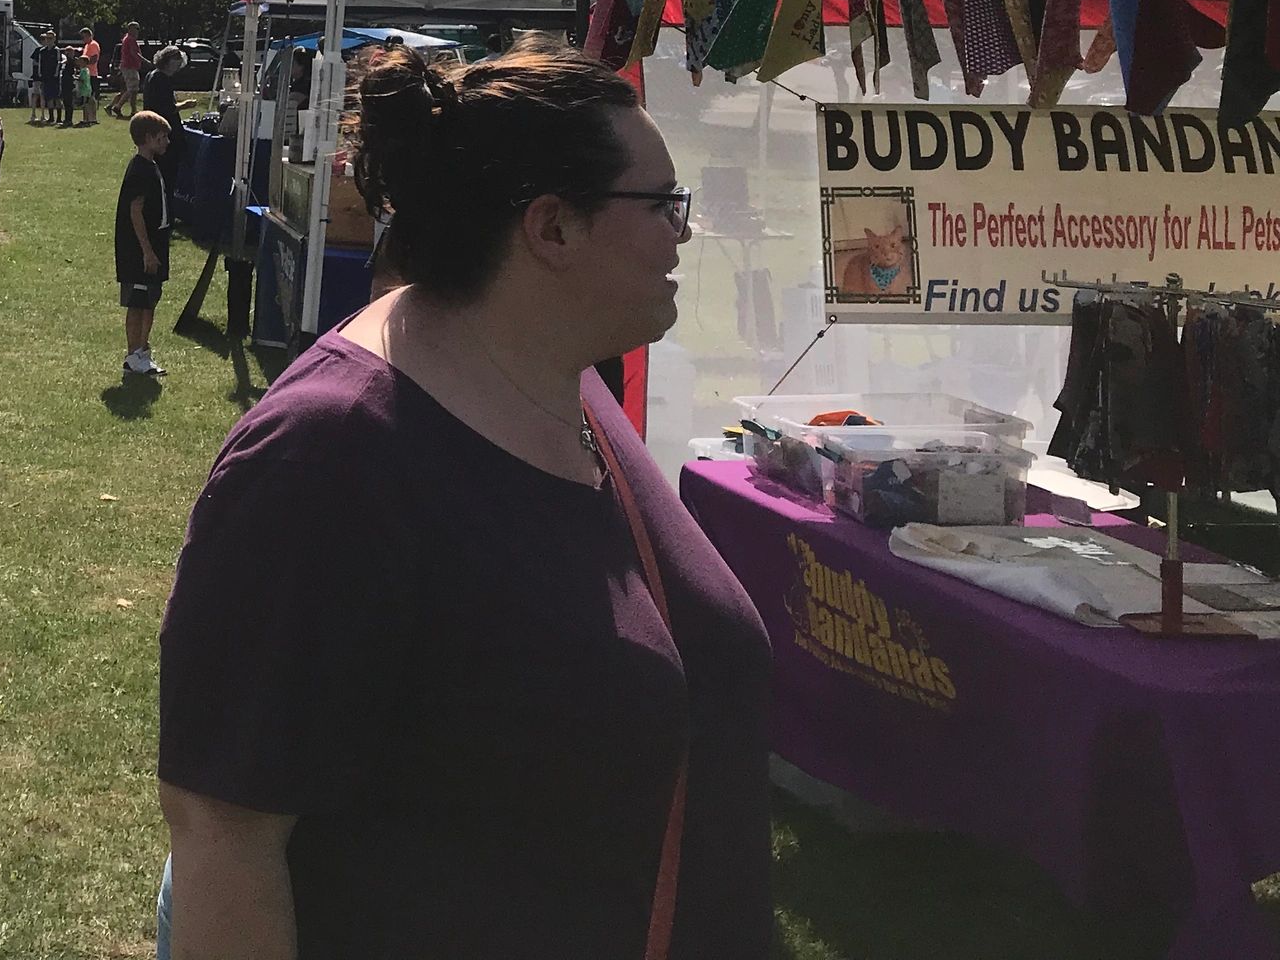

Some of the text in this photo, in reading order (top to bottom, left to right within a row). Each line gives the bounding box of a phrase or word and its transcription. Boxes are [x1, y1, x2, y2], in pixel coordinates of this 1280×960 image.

[824, 110, 1032, 172] BUDDY
[928, 202, 1280, 262] The Perfect Accessory for ALL Pets
[924, 279, 1061, 313] Find us
